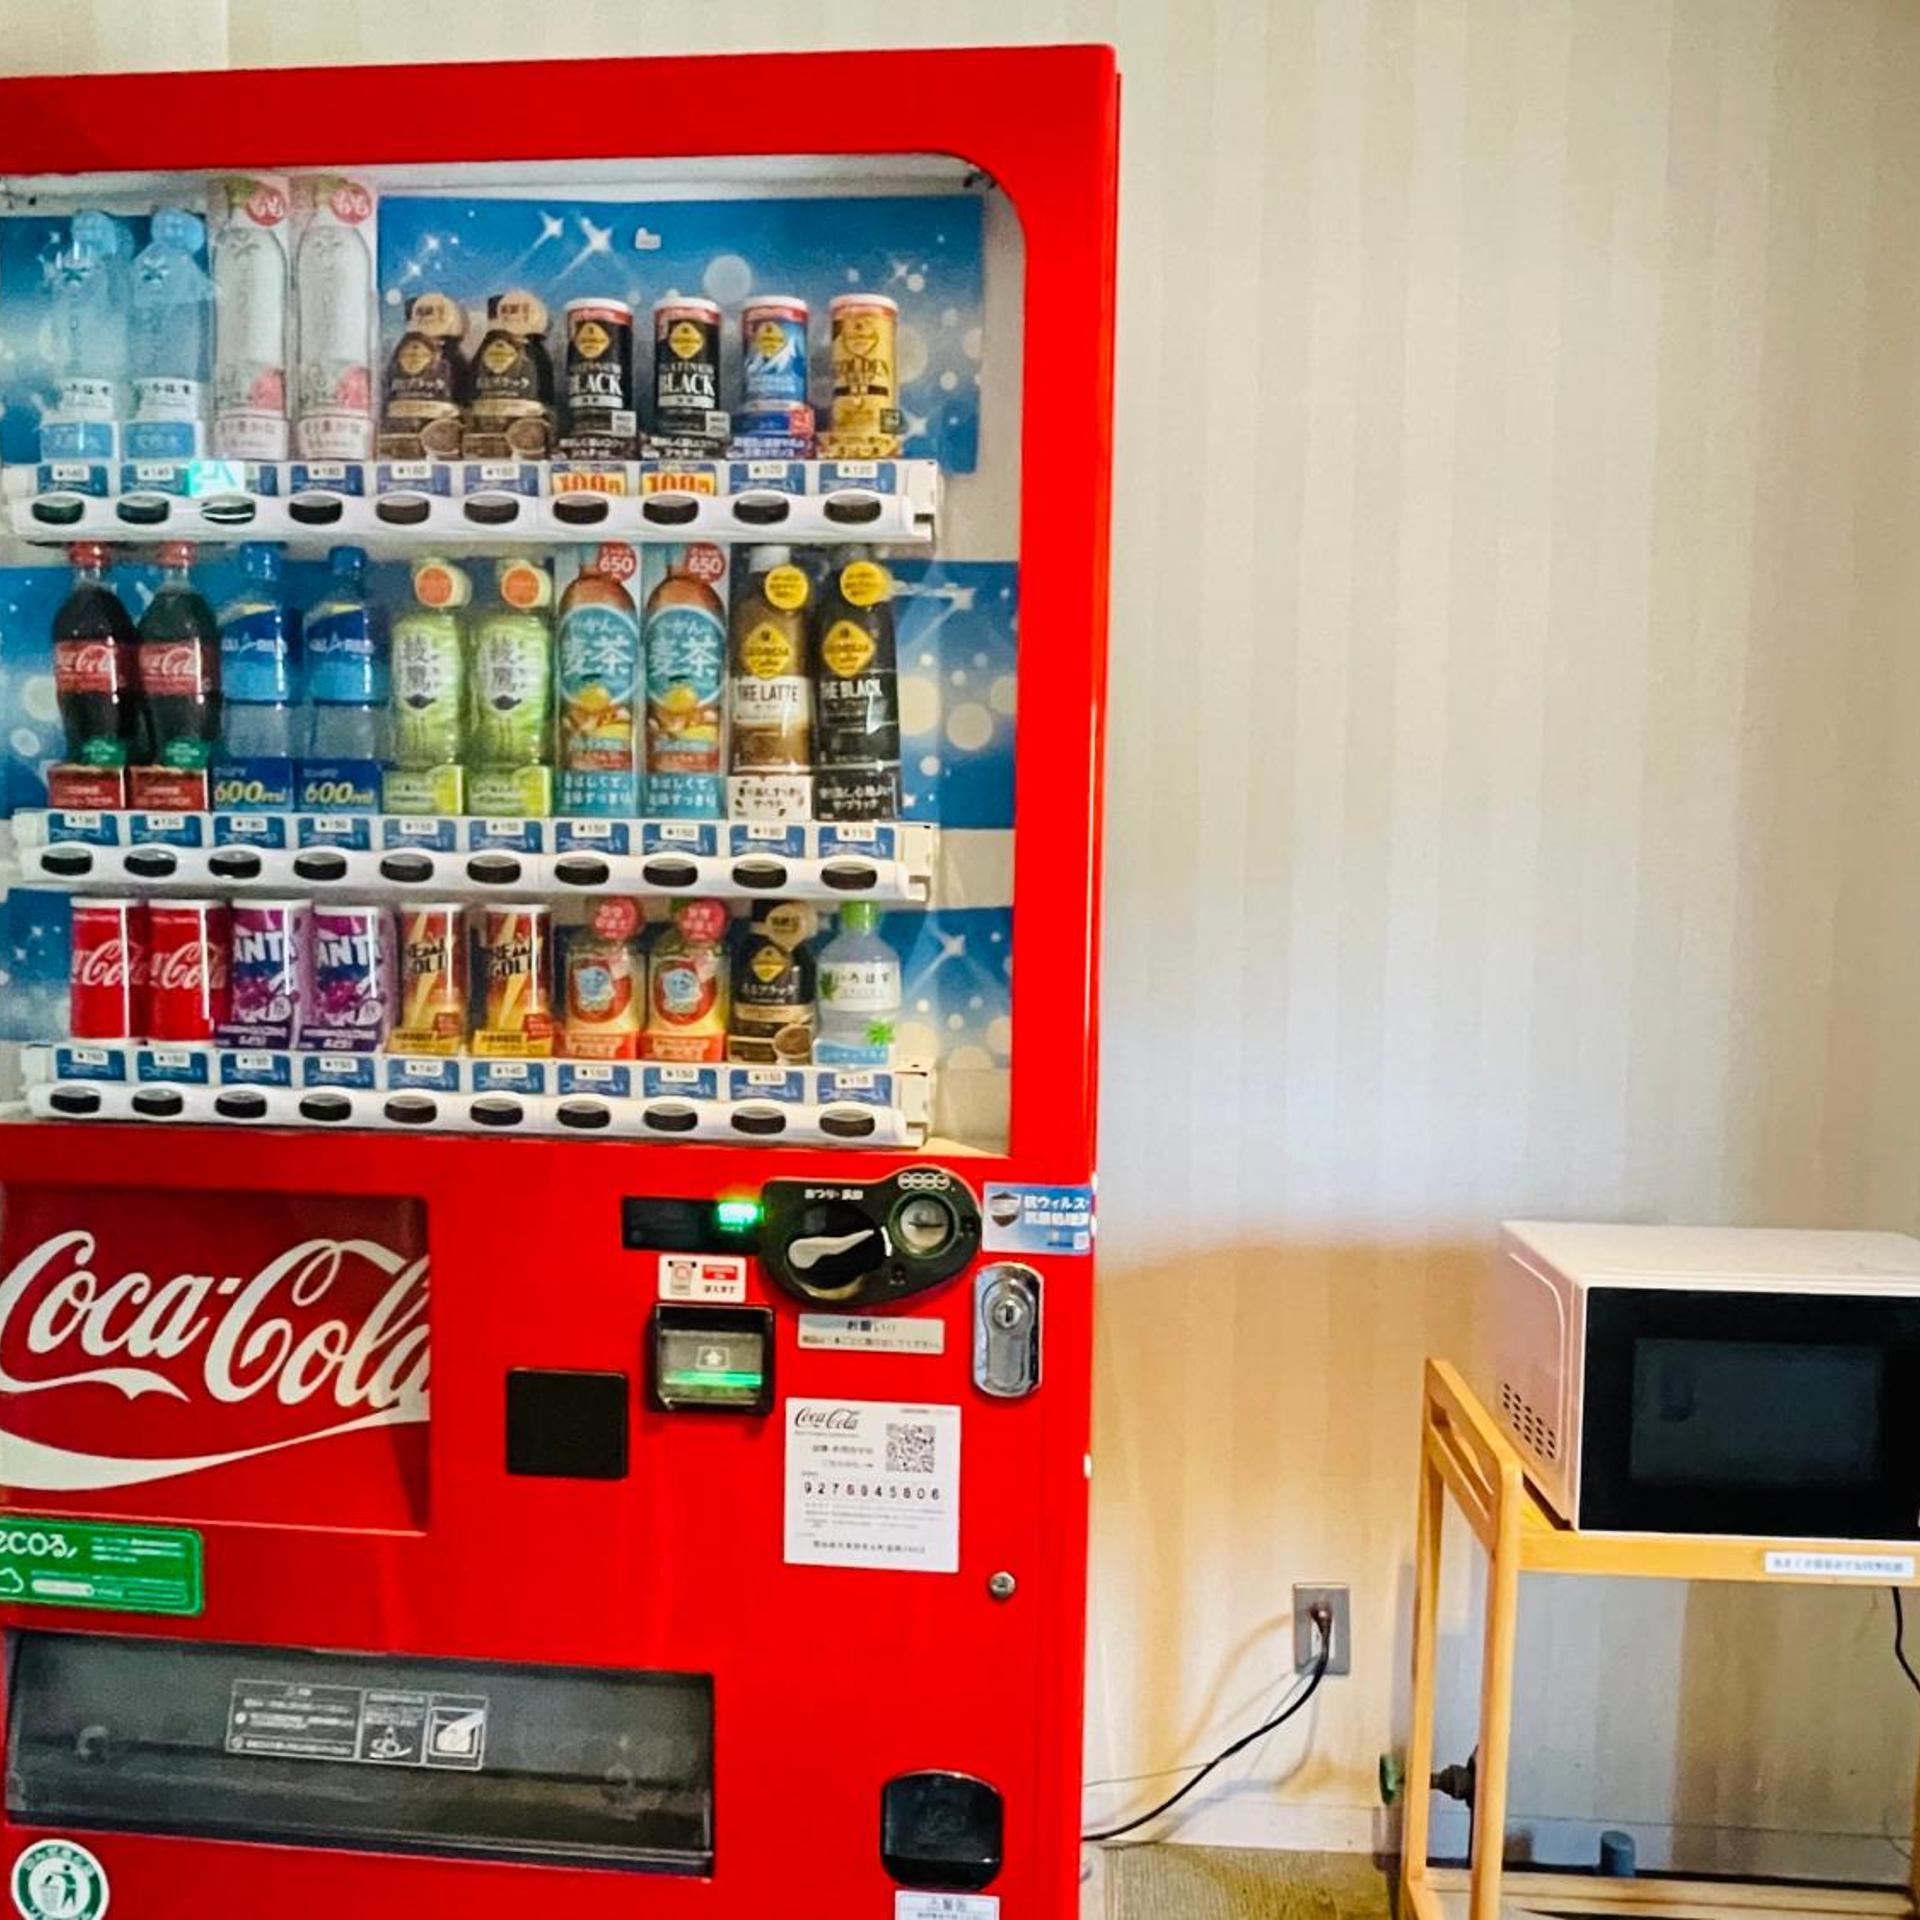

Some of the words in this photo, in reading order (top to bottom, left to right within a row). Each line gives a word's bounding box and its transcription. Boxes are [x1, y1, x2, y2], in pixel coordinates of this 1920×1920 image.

[759, 684, 799, 702] LATTE
[840, 679, 883, 699] BLACK
[0, 1230, 430, 1410] Coca-Cola
